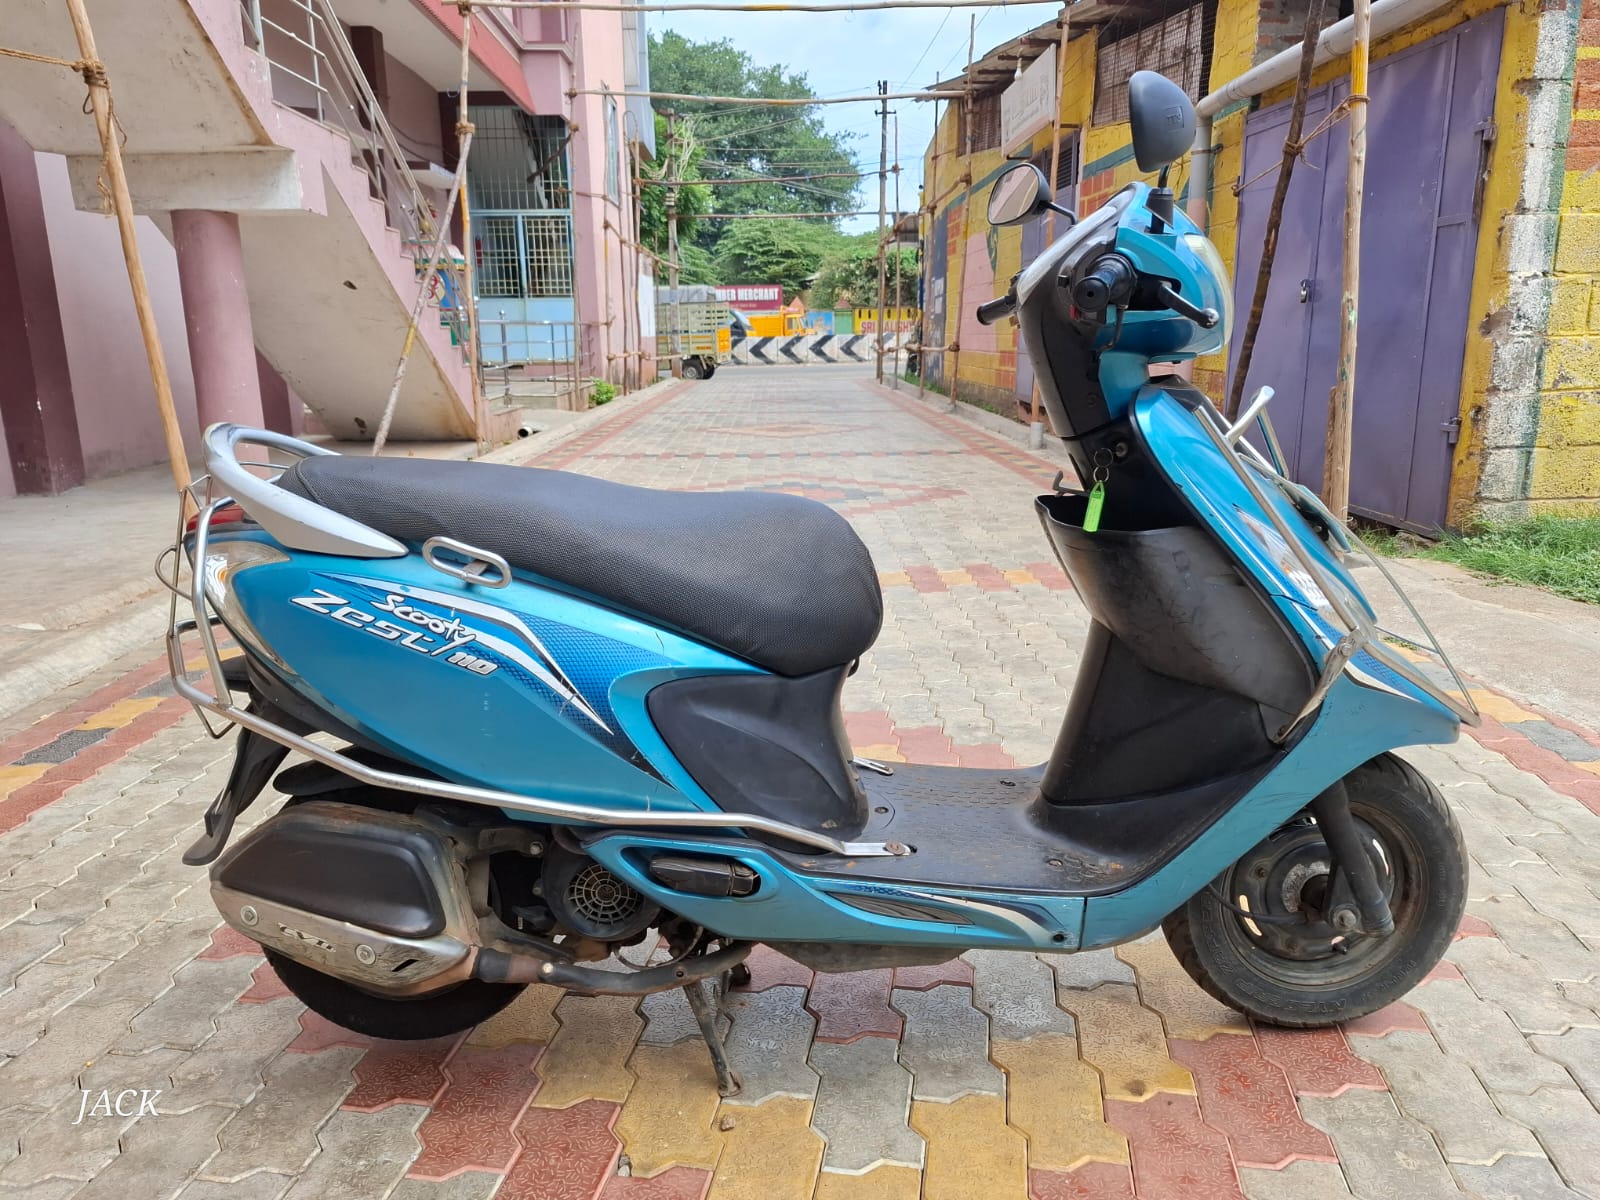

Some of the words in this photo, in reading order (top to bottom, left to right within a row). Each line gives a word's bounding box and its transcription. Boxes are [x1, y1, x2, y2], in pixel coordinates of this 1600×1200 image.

[738, 288, 779, 301] MERCHANT
[861, 321, 876, 333] SRI
[371, 593, 477, 656] Scooty
[446, 651, 499, 676] 110
